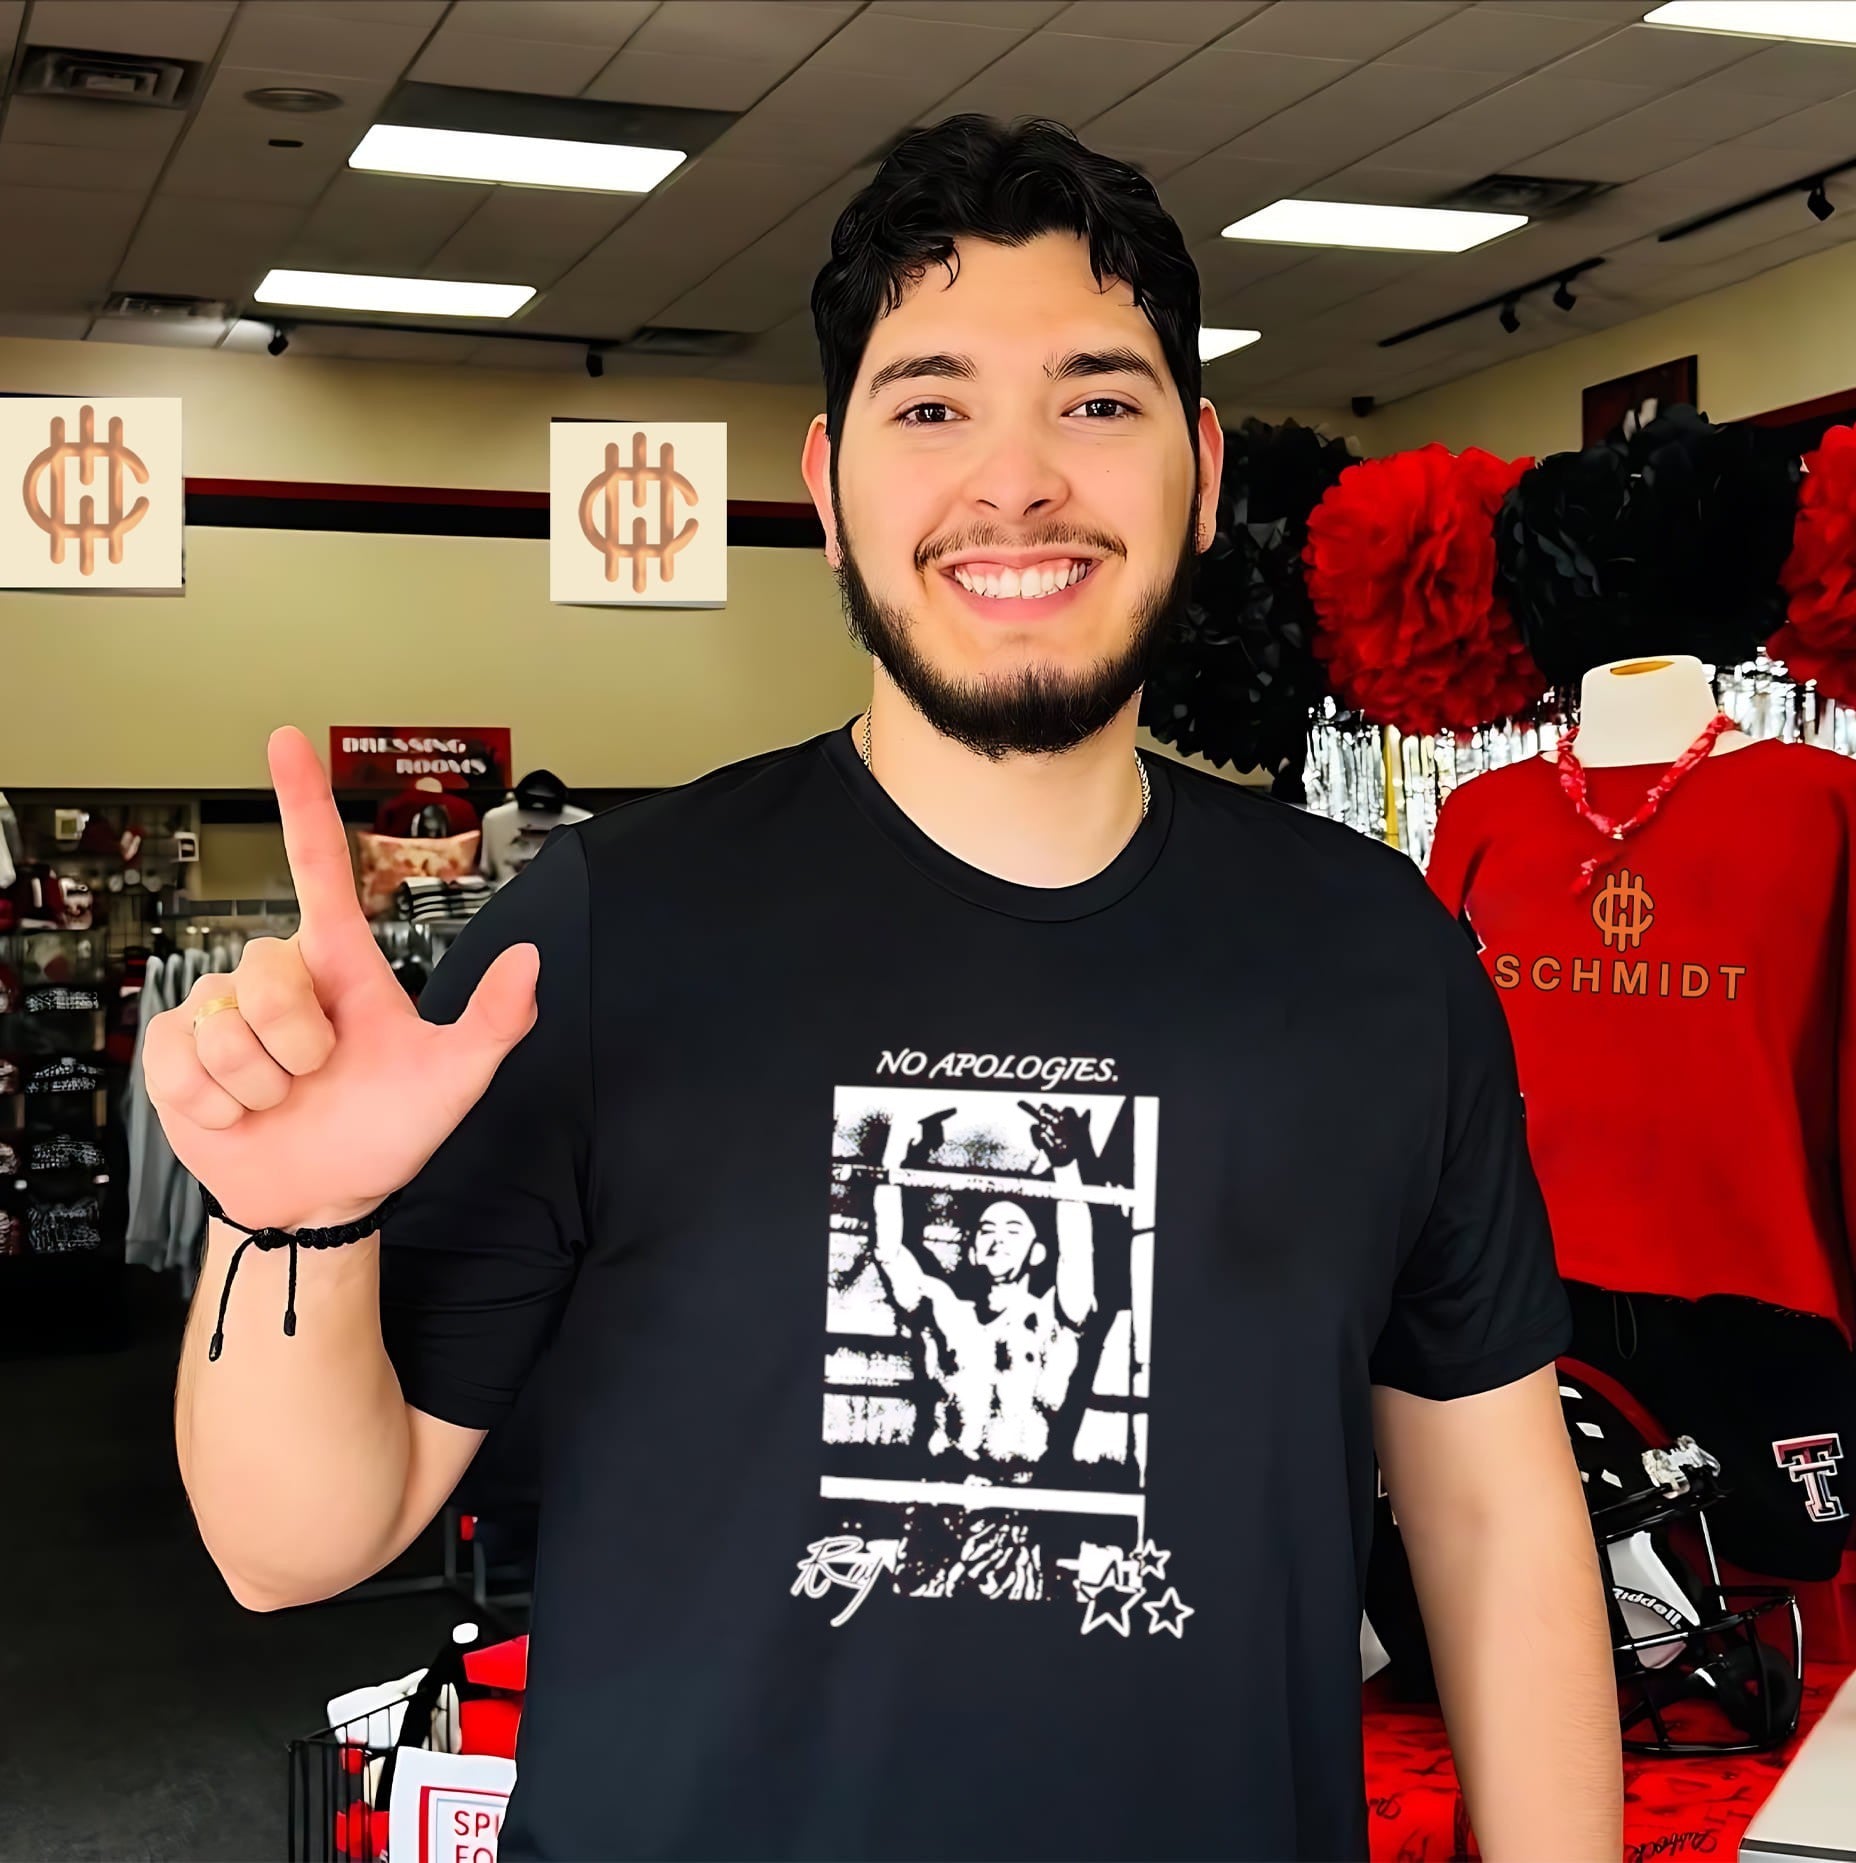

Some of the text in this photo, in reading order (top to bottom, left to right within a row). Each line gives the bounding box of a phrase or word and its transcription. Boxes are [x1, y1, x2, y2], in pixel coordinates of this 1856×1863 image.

[342, 737, 467, 754] DRESSING
[396, 758, 487, 775] ROOMS
[1494, 953, 1747, 1001] SCHMIDT
[876, 1048, 1118, 1091] NO APOLOGIES.
